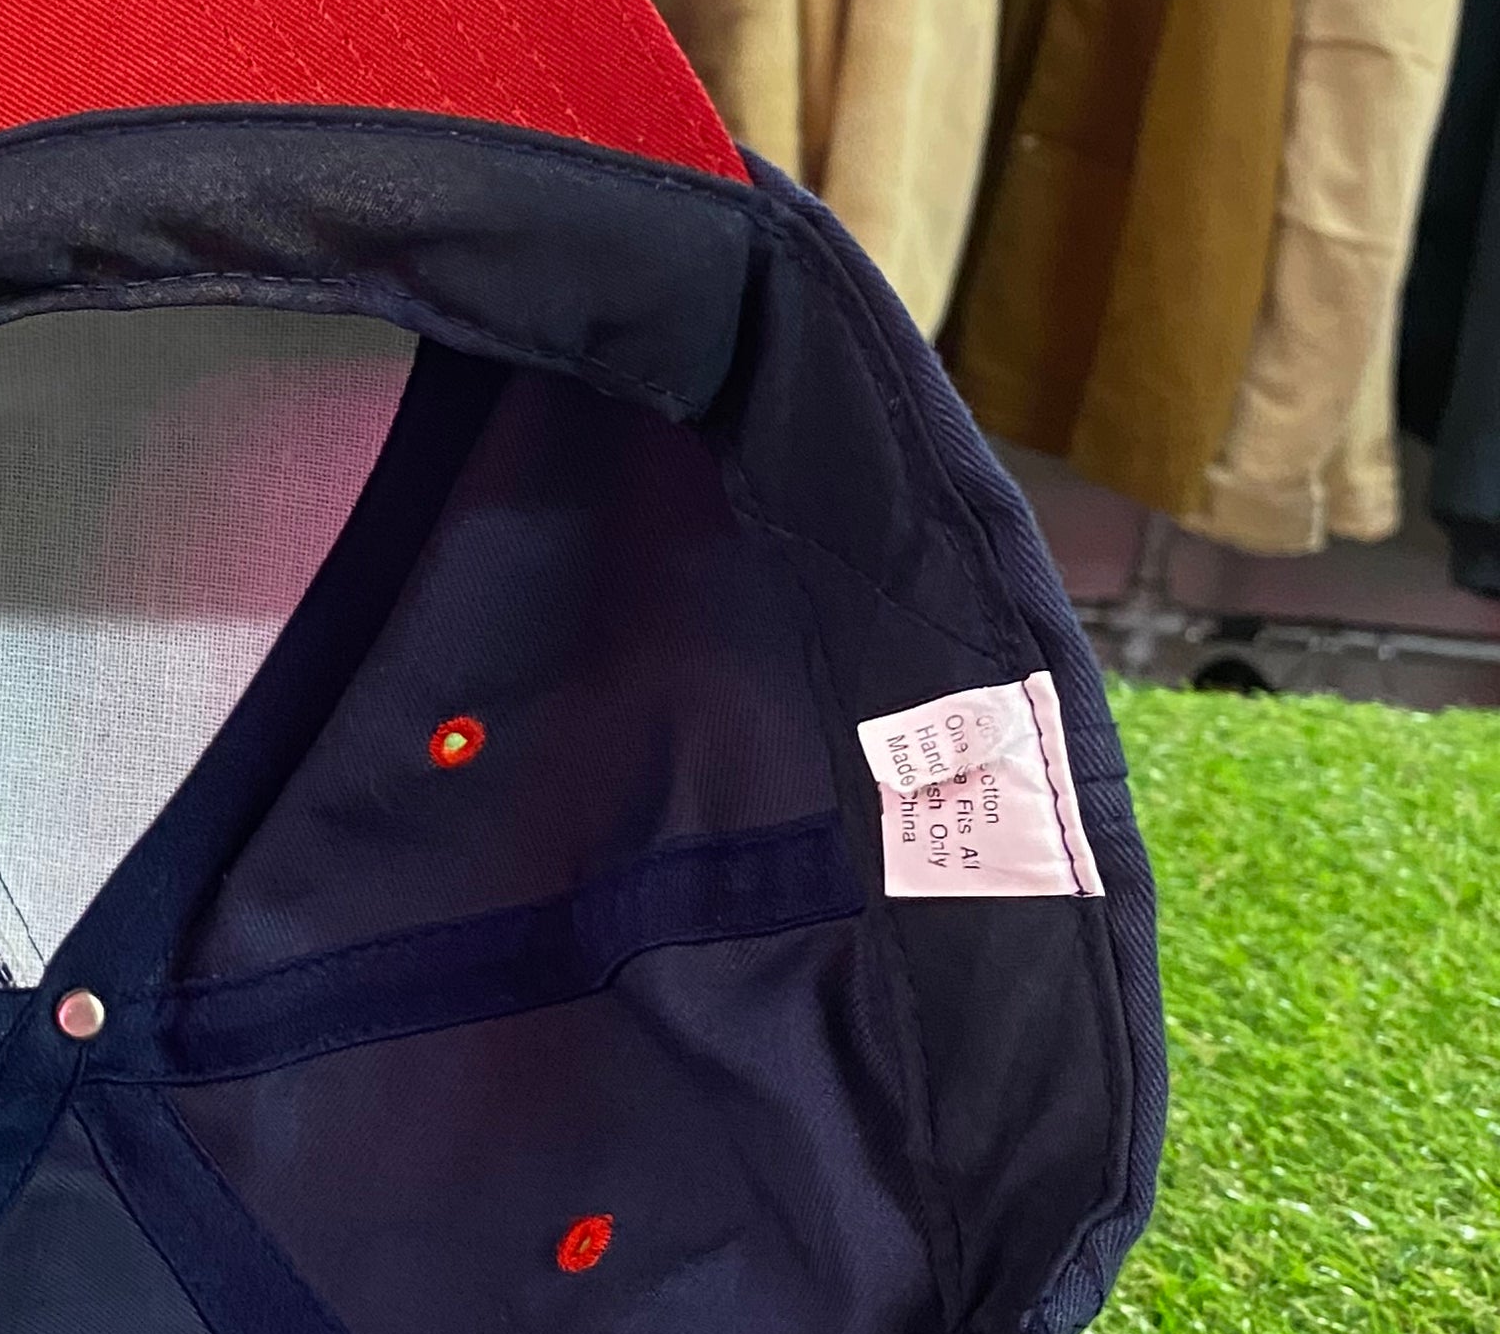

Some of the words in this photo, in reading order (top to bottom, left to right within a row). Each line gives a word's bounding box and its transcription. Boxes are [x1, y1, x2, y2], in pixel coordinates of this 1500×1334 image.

[915, 723, 950, 776] Hand
[945, 713, 970, 754] One
[885, 734, 920, 787] Made
[956, 799, 975, 835] Fits
[928, 823, 949, 869] Only
